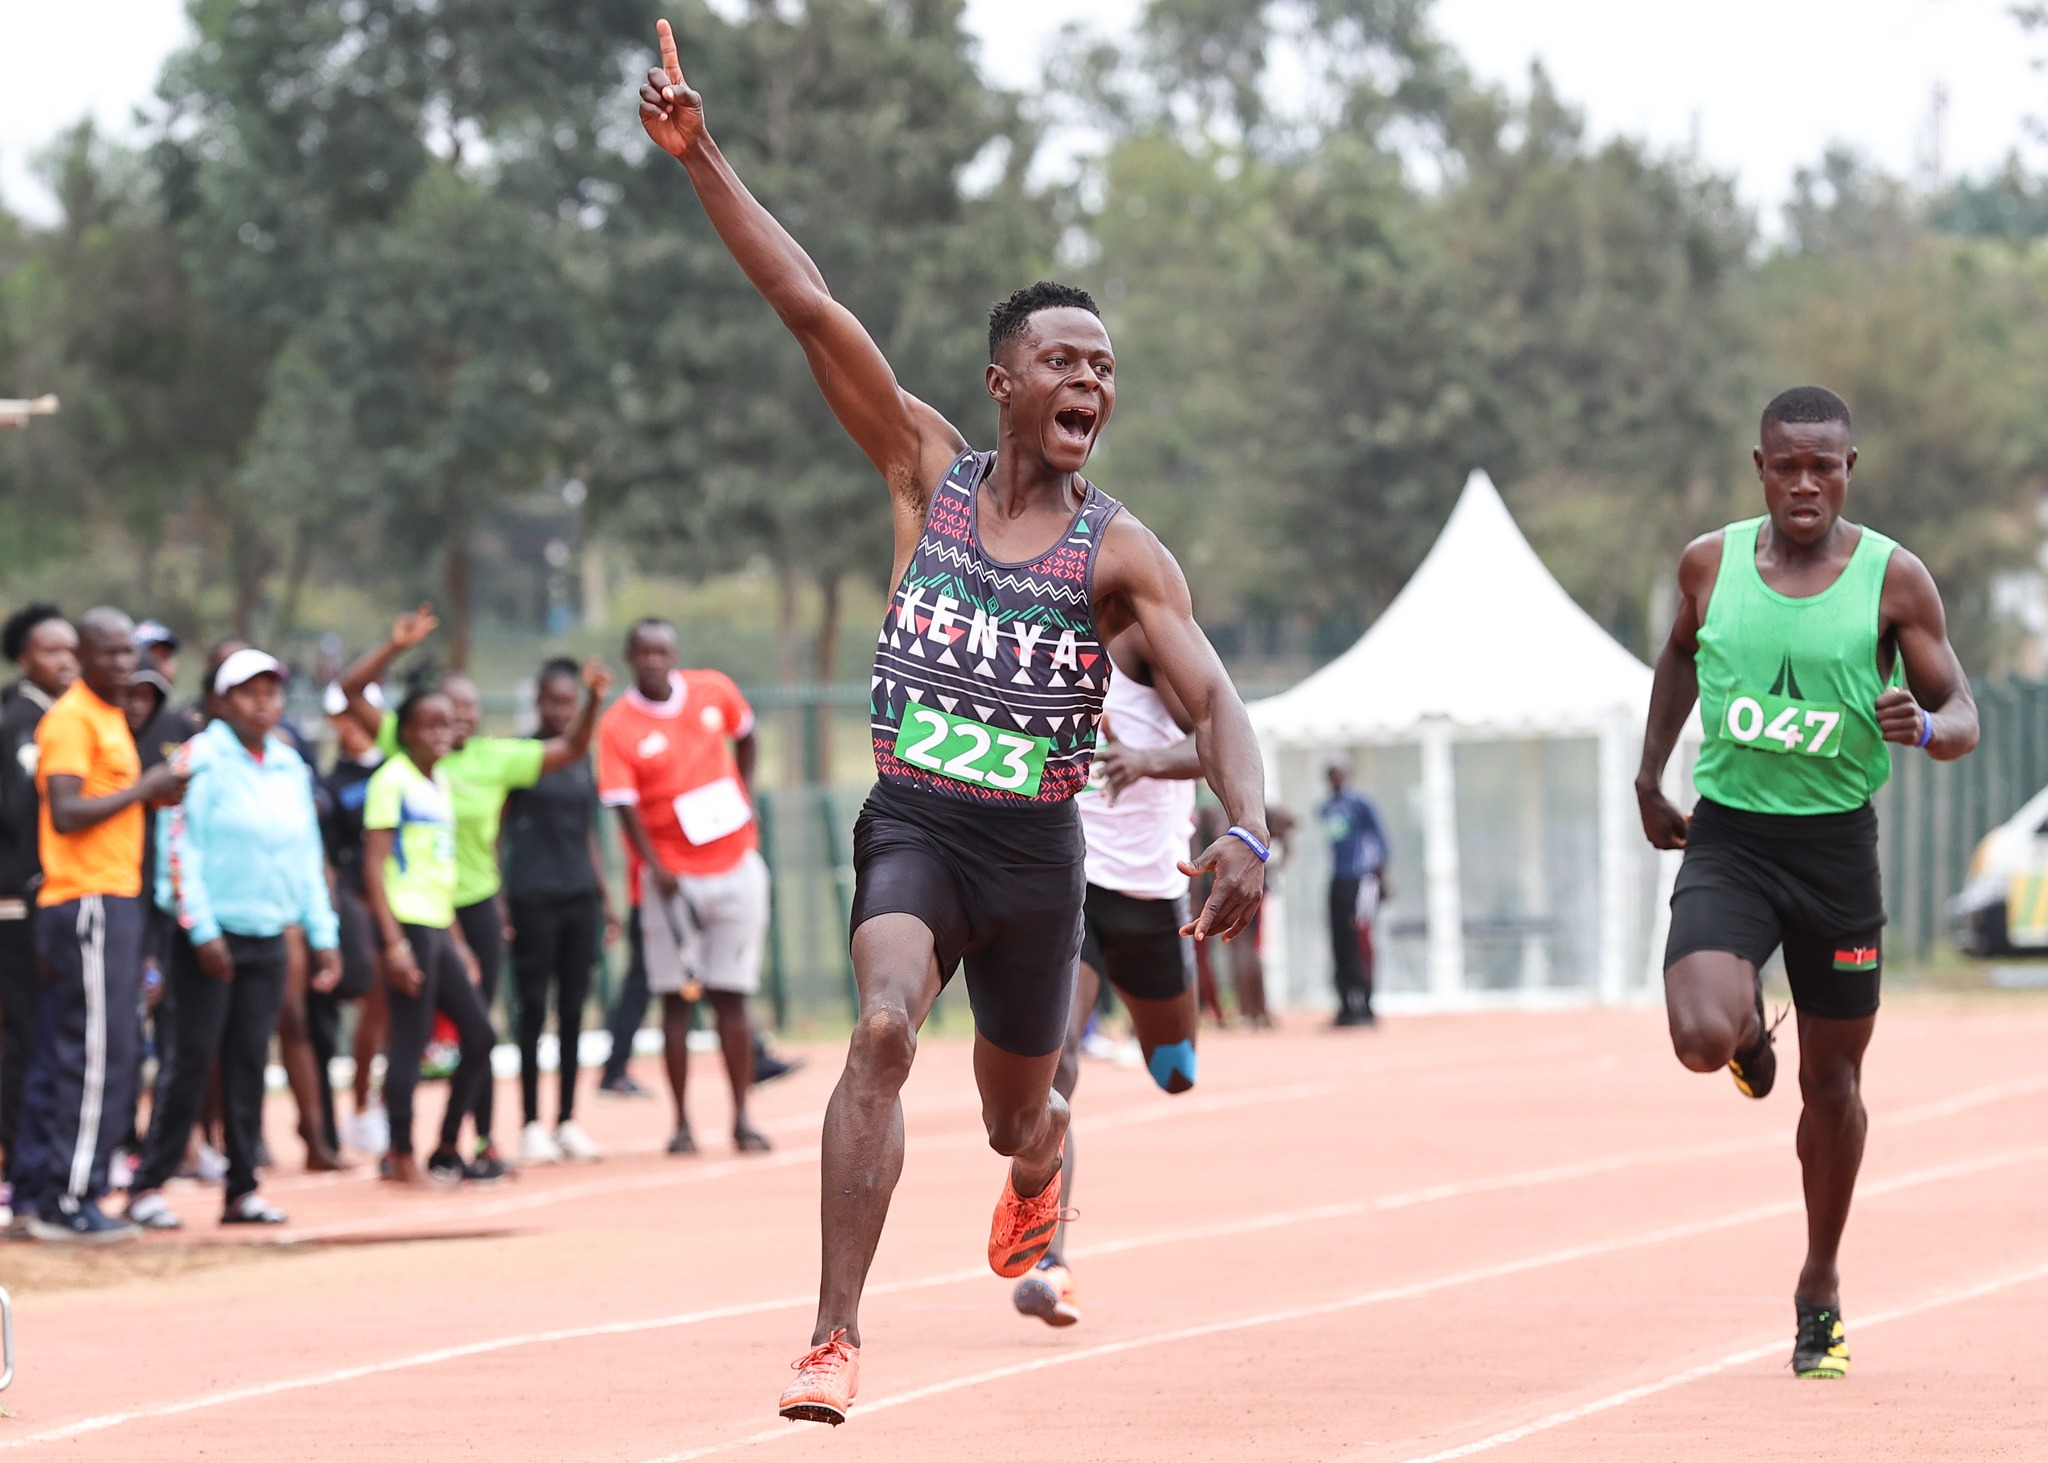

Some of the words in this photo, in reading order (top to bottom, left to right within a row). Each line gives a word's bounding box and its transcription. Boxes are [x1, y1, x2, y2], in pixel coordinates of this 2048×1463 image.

[897, 582, 1079, 671] KENYA
[904, 709, 1036, 789] 223
[1727, 695, 1840, 753] 047
